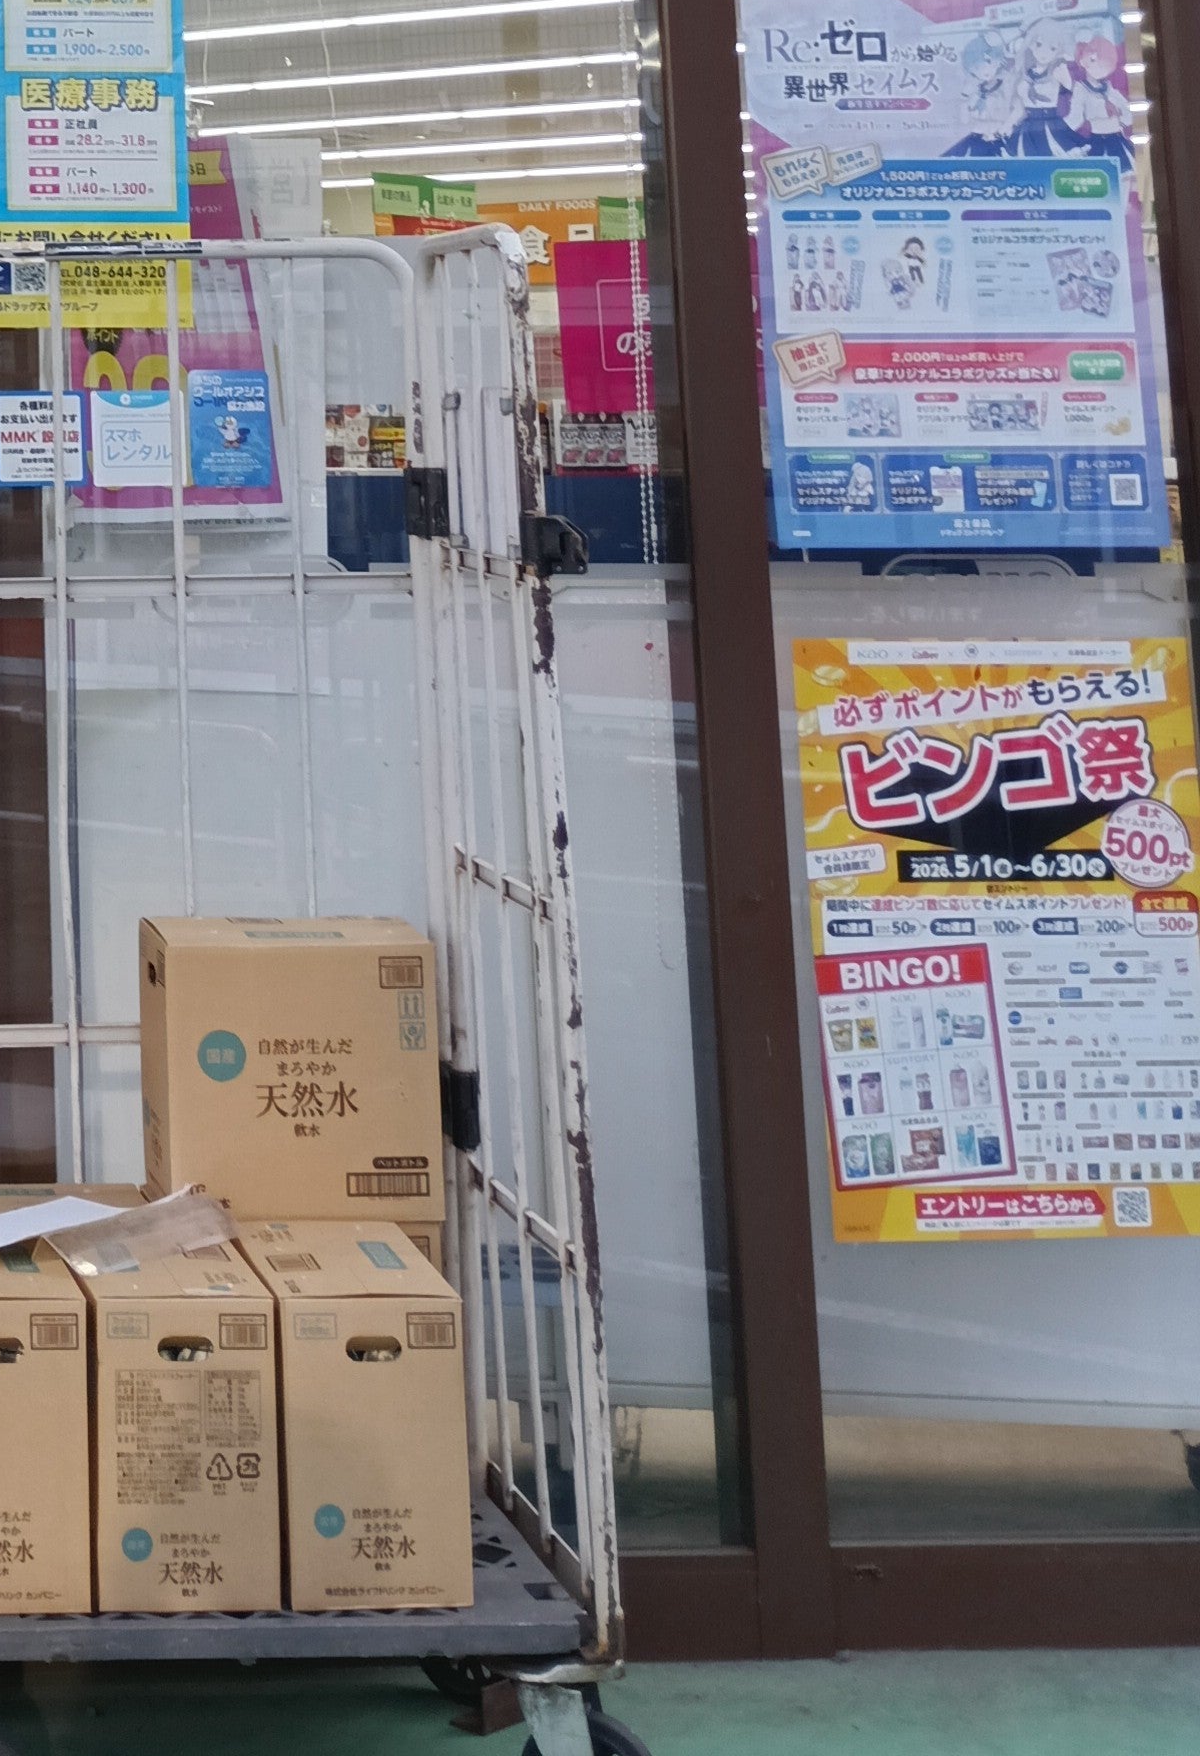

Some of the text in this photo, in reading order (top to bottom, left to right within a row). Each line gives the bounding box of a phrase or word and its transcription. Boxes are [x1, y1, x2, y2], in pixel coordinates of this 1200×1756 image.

[63, 28, 94, 38] パート
[784, 68, 939, 102] 異世界セイムス
[20, 77, 158, 112] 医療事務
[64, 118, 98, 130] 正社員
[66, 167, 97, 177] パート
[773, 151, 822, 178] もれなく
[840, 185, 1045, 199] オリジナルコラボステッカープレゼント!
[518, 198, 597, 213] DAILY FOODS
[789, 341, 828, 362] 抽選で
[0, 429, 80, 444] MMK 設店
[105, 428, 142, 443] スマホ
[107, 444, 174, 462] レンタル
[833, 669, 1152, 728] 必ずポイントがもらえる!
[845, 719, 1149, 824] ビンゴ祭
[1137, 804, 1162, 818] 最大
[1115, 815, 1184, 833] セイムスポイント
[1105, 826, 1192, 868] 500pt
[813, 848, 877, 864] セイムスアプリ
[839, 954, 962, 991] BINGO!
[258, 1037, 353, 1055] 自然が生んだ
[276, 1061, 337, 1077] まろやか
[255, 1080, 360, 1119] 天然水
[293, 1123, 321, 1137] 軟水
[920, 1194, 1096, 1215] エントリーはこちらから
[352, 1507, 413, 1520] 自然が生んだ
[363, 1521, 403, 1533] まろやか
[159, 1533, 221, 1545] 自然が生んだ
[351, 1534, 417, 1560] 天然水
[171, 1547, 211, 1559] まろやか
[158, 1560, 223, 1586] 天然水
[374, 1562, 392, 1572] 軟水
